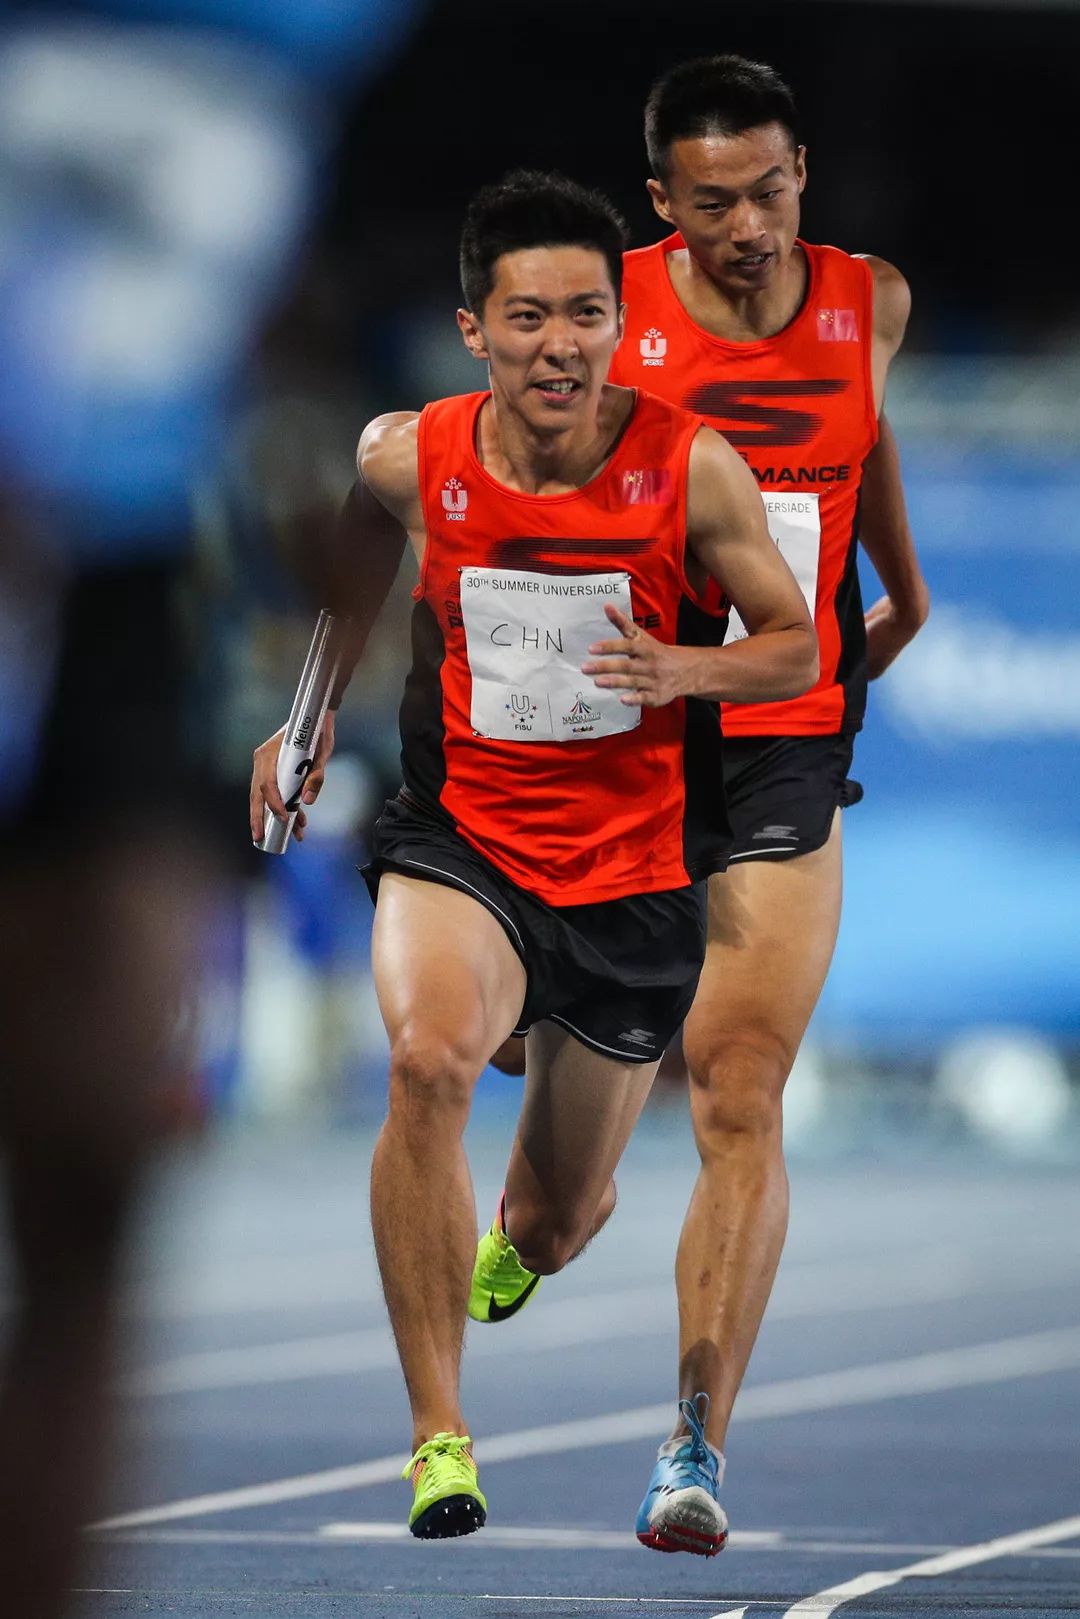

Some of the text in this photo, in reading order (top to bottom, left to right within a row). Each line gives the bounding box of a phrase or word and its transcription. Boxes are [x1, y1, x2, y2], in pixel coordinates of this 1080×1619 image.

[492, 579, 540, 593] SUMMER
[543, 583, 621, 597] UNIVERSIADE
[490, 623, 564, 653] CHN
